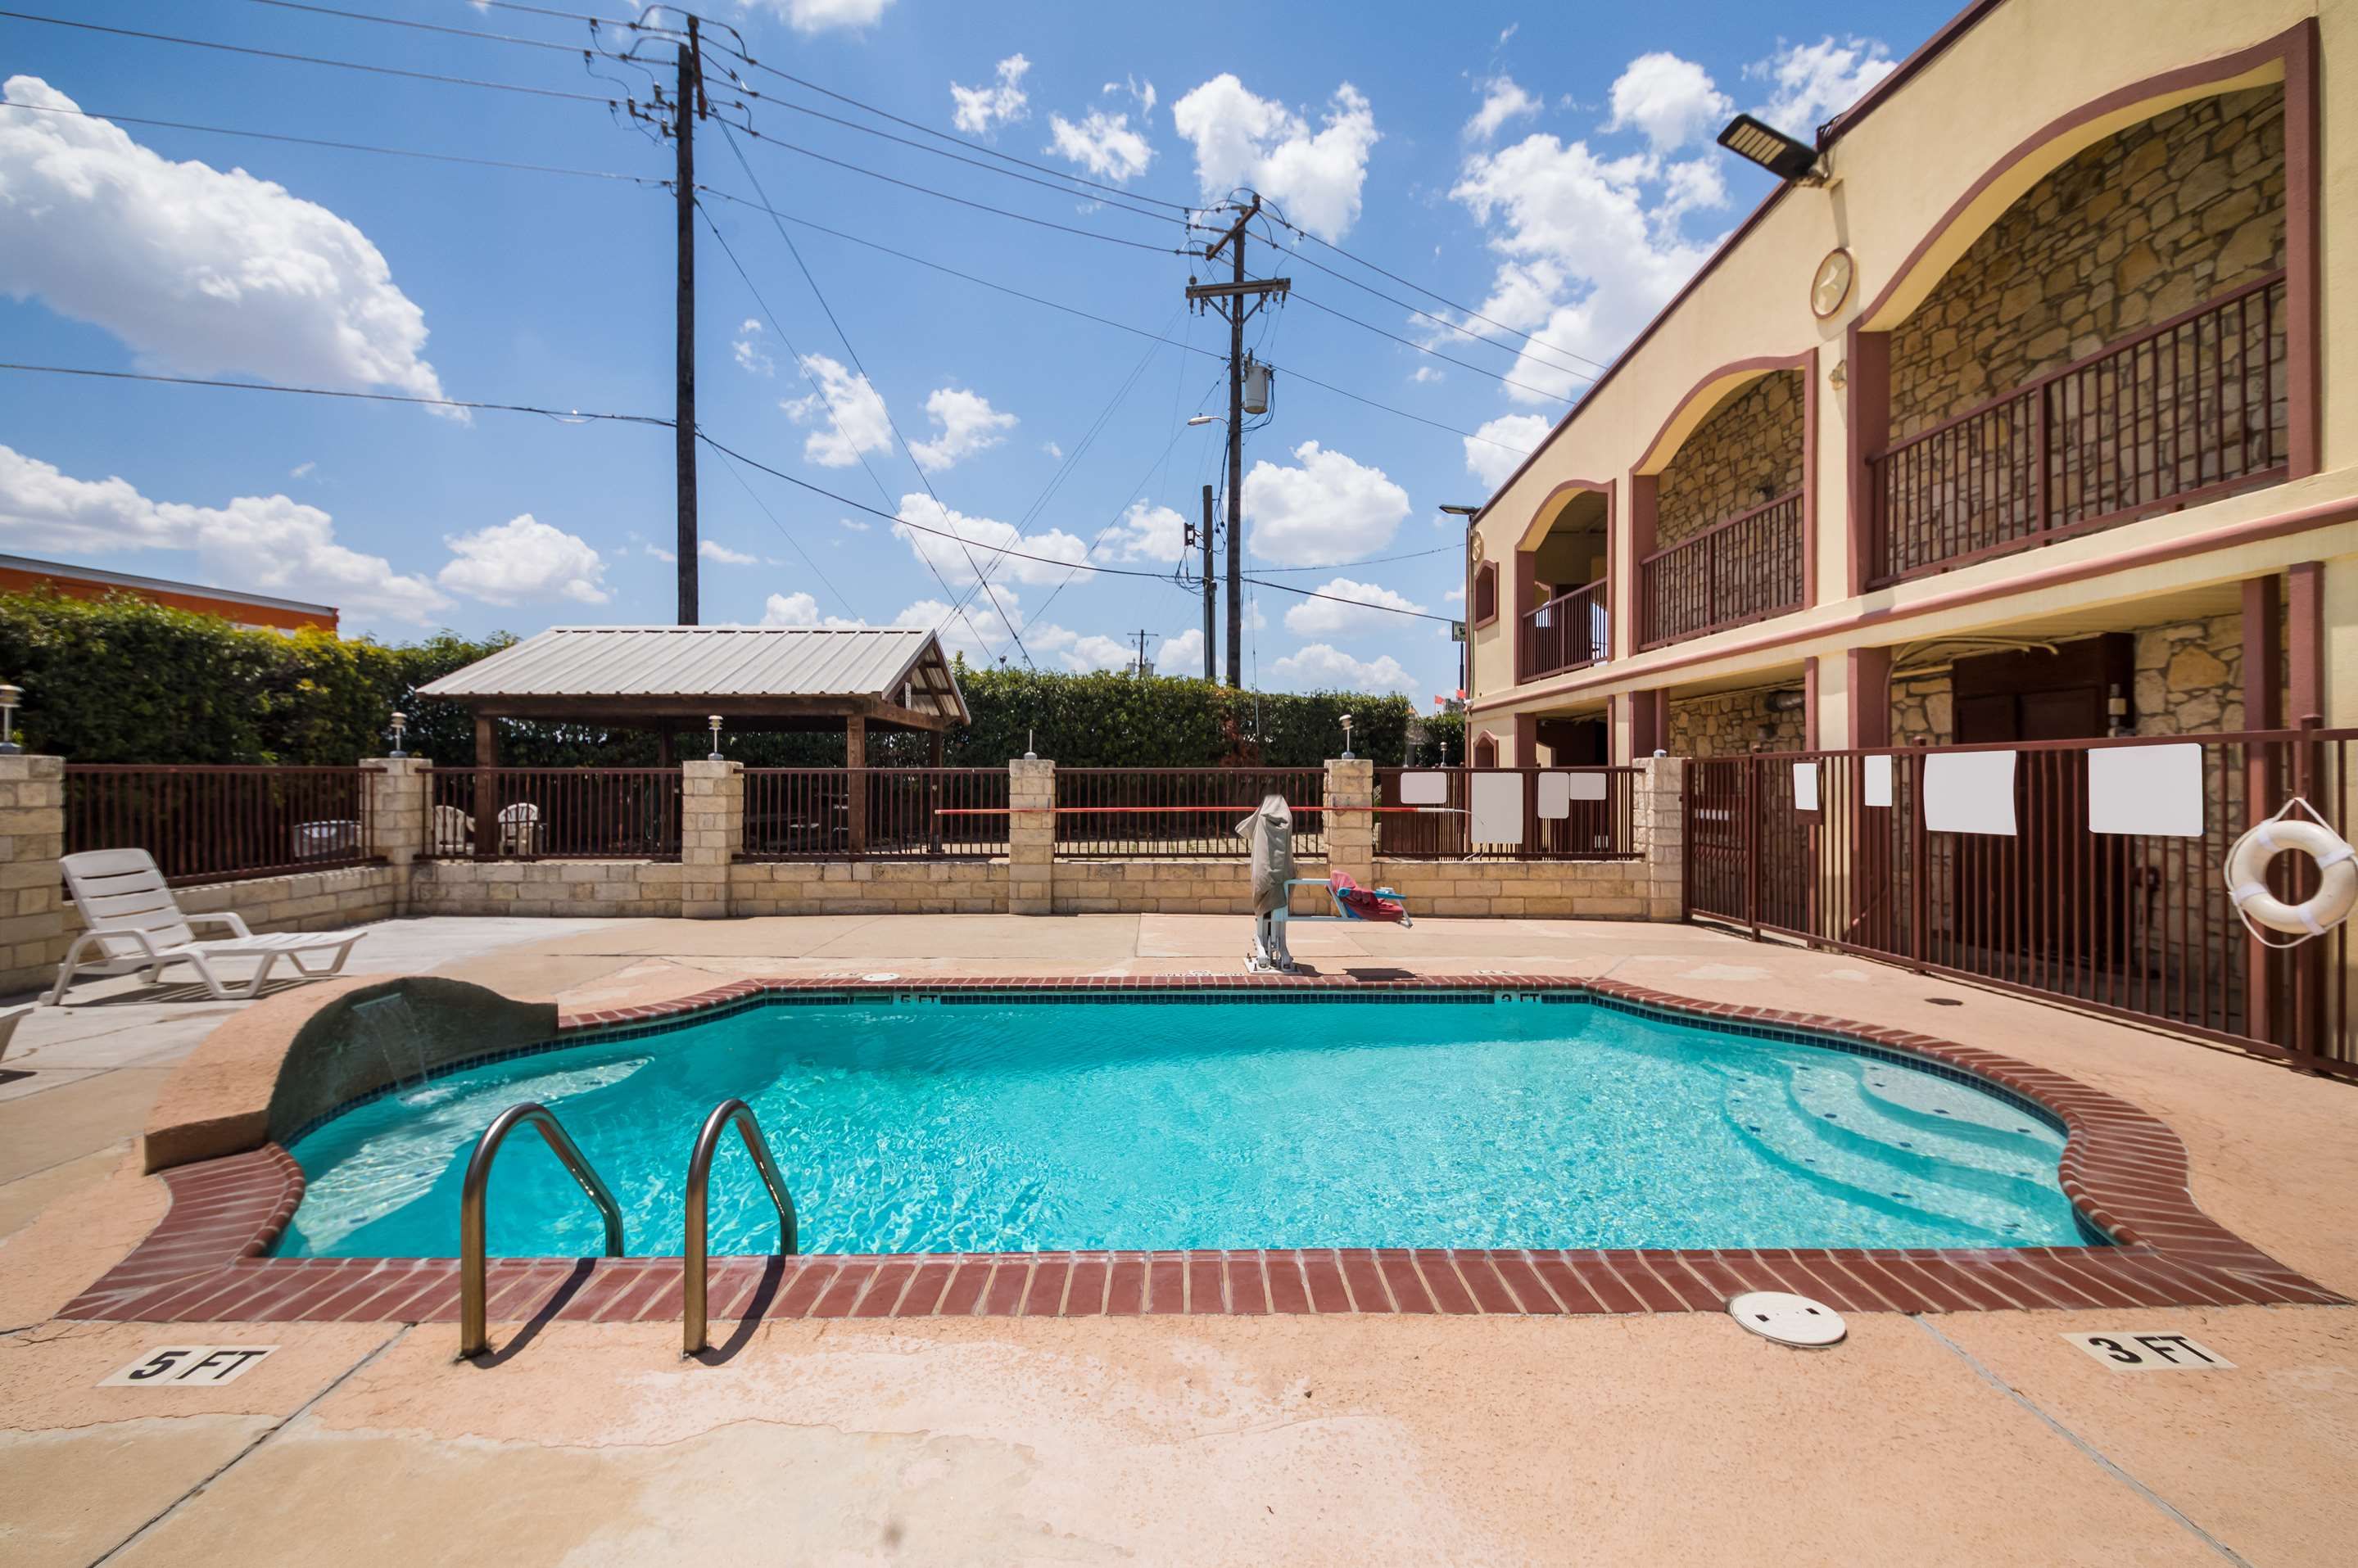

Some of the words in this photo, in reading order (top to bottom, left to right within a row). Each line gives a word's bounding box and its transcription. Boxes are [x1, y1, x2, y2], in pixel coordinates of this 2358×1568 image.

[2088, 1337, 2143, 1364] 3
[2134, 1336, 2215, 1364] FT
[129, 1351, 191, 1380] 5
[175, 1350, 268, 1380] FT
